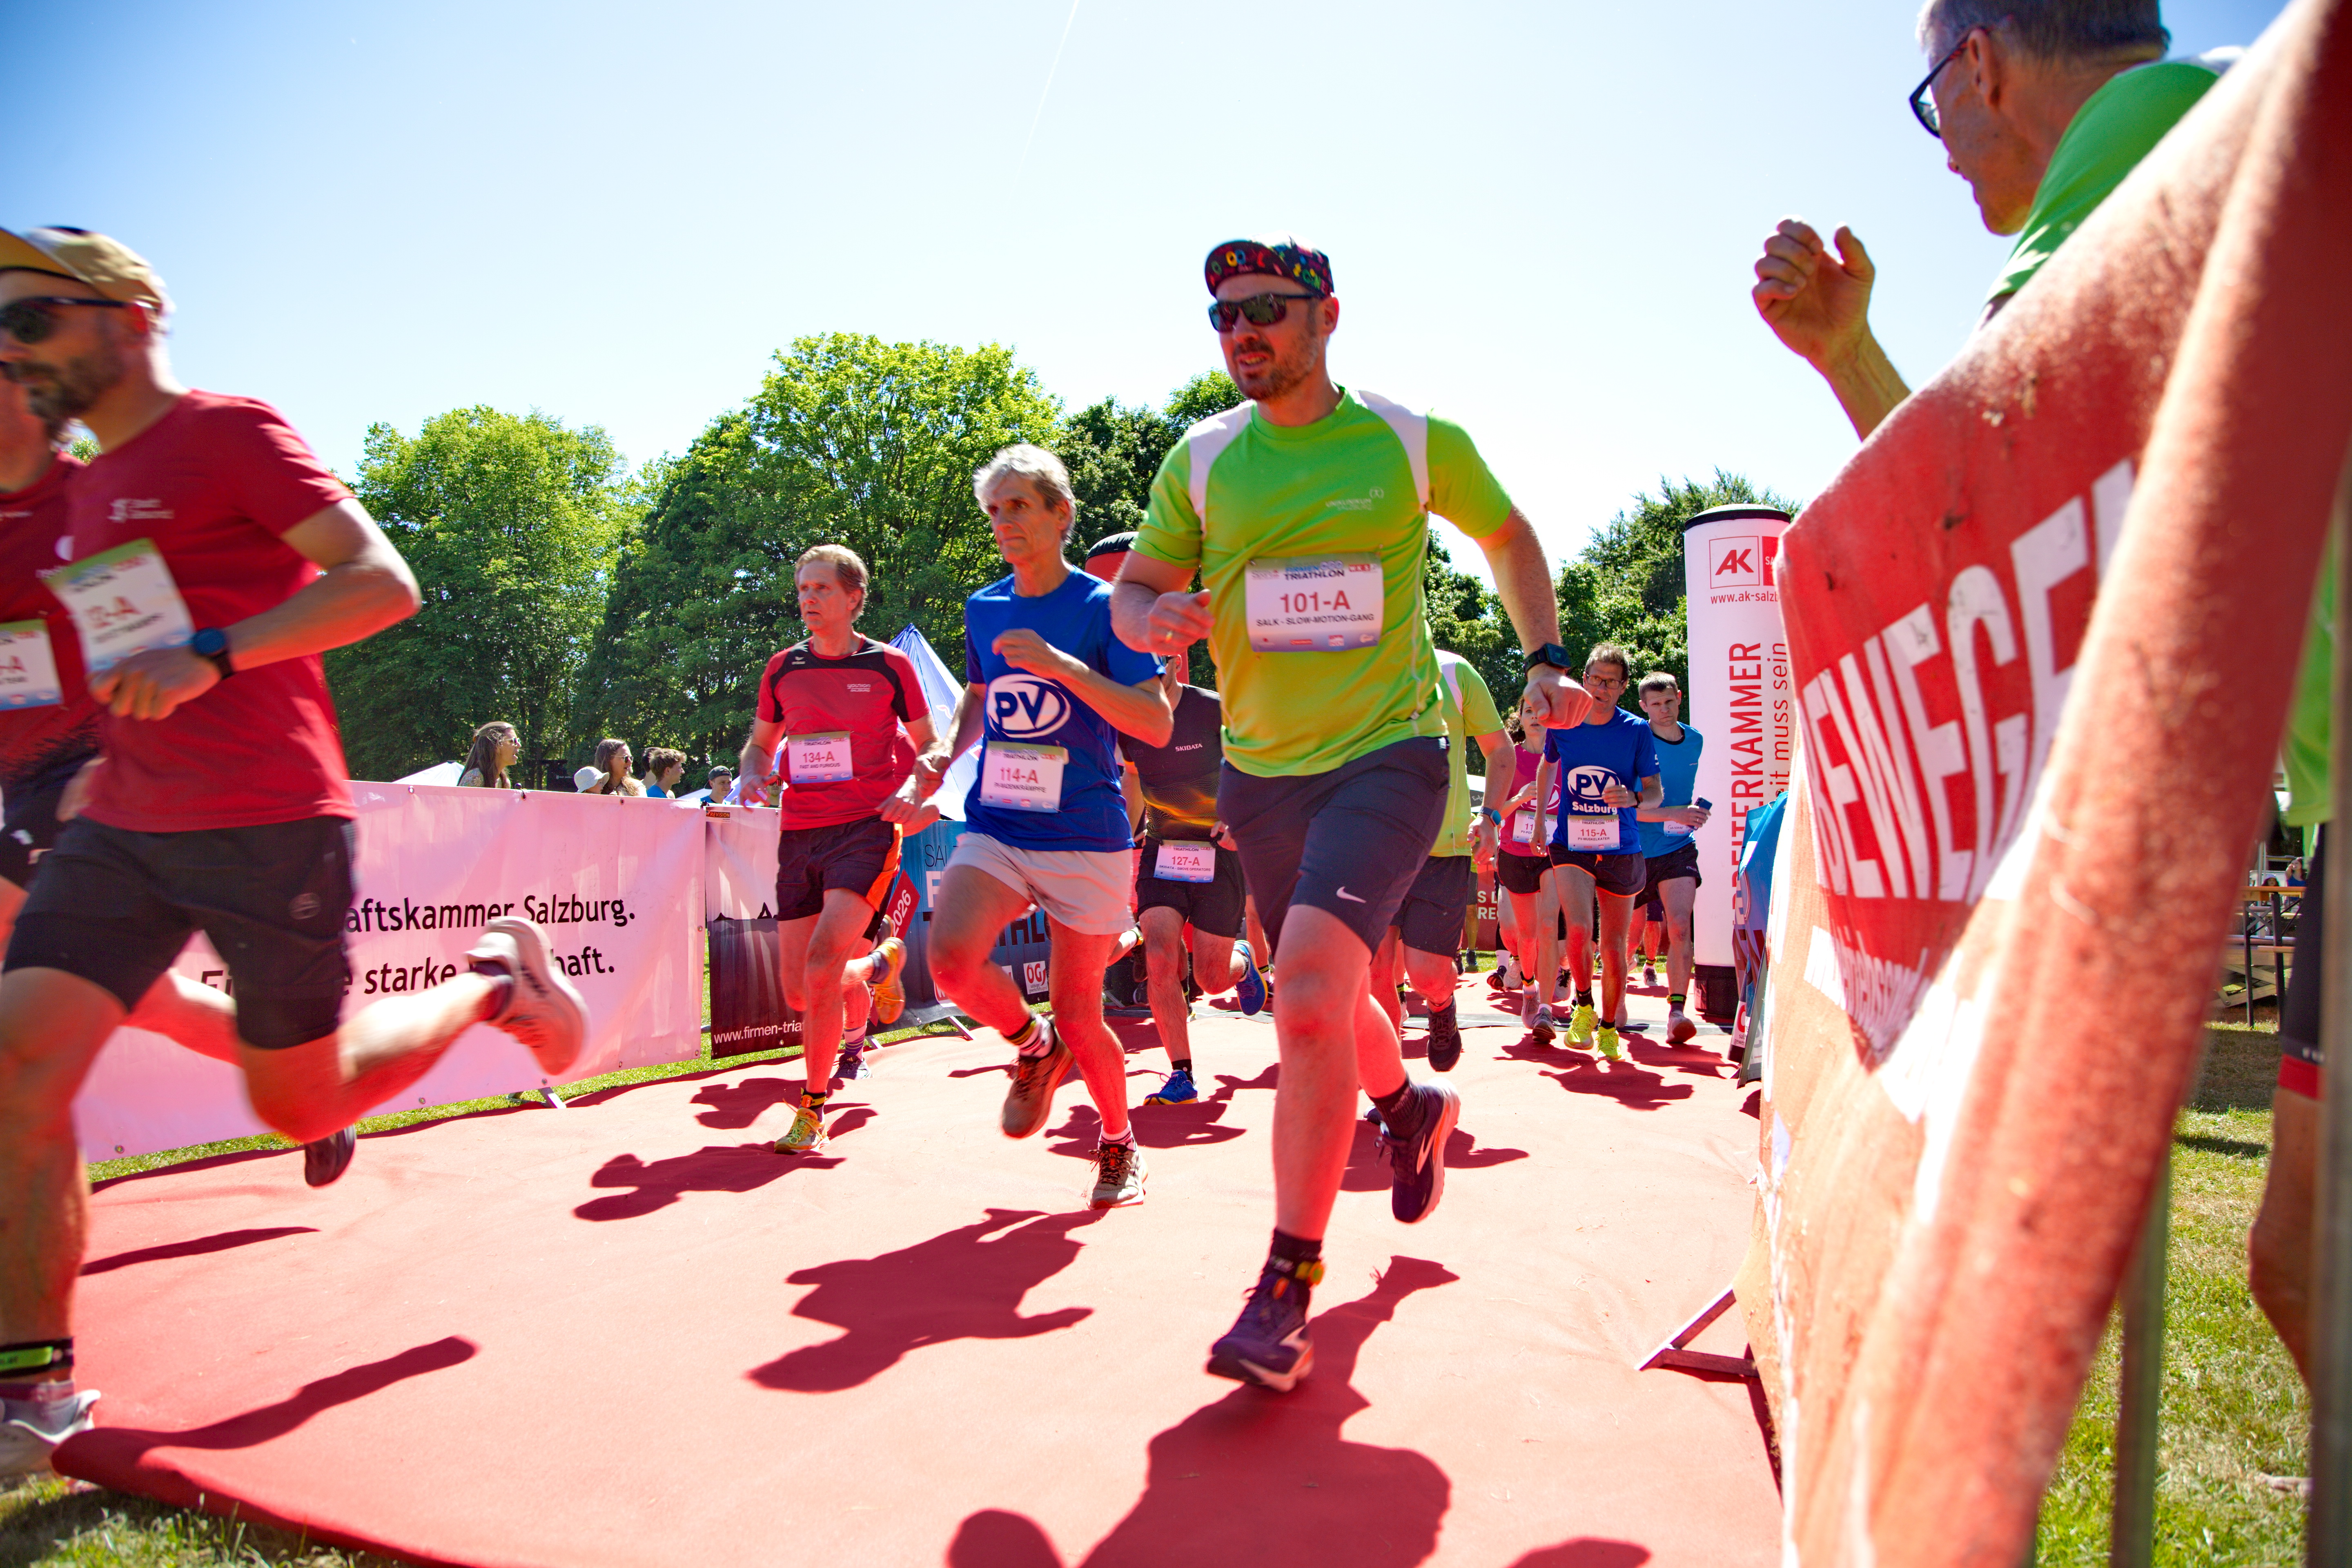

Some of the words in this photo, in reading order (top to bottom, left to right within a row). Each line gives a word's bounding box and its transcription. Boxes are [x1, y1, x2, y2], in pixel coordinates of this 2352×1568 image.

[1715, 549, 1754, 575] AK
[1283, 570, 1345, 581] TRIATHLON
[1280, 590, 1351, 613] 101-A
[1711, 591, 1779, 604] www.ak-salzb
[1256, 619, 1279, 627] SALK
[1286, 613, 1374, 625] SLOW-MOTION-GANG
[1767, 642, 1787, 690] sein
[994, 686, 1046, 730] PV
[1774, 699, 1789, 760] muss
[803, 751, 835, 763] 134-A
[1175, 743, 1203, 752] SKIDATA
[1000, 767, 1039, 784] 114-A
[1576, 773, 1610, 796] PV
[1572, 801, 1617, 815] Salzburg
[1172, 856, 1200, 866] 127-A
[342, 897, 515, 933] aftskammer
[524, 893, 635, 927] Salzburg.
[890, 889, 911, 937] 2026
[363, 956, 457, 995] starke
